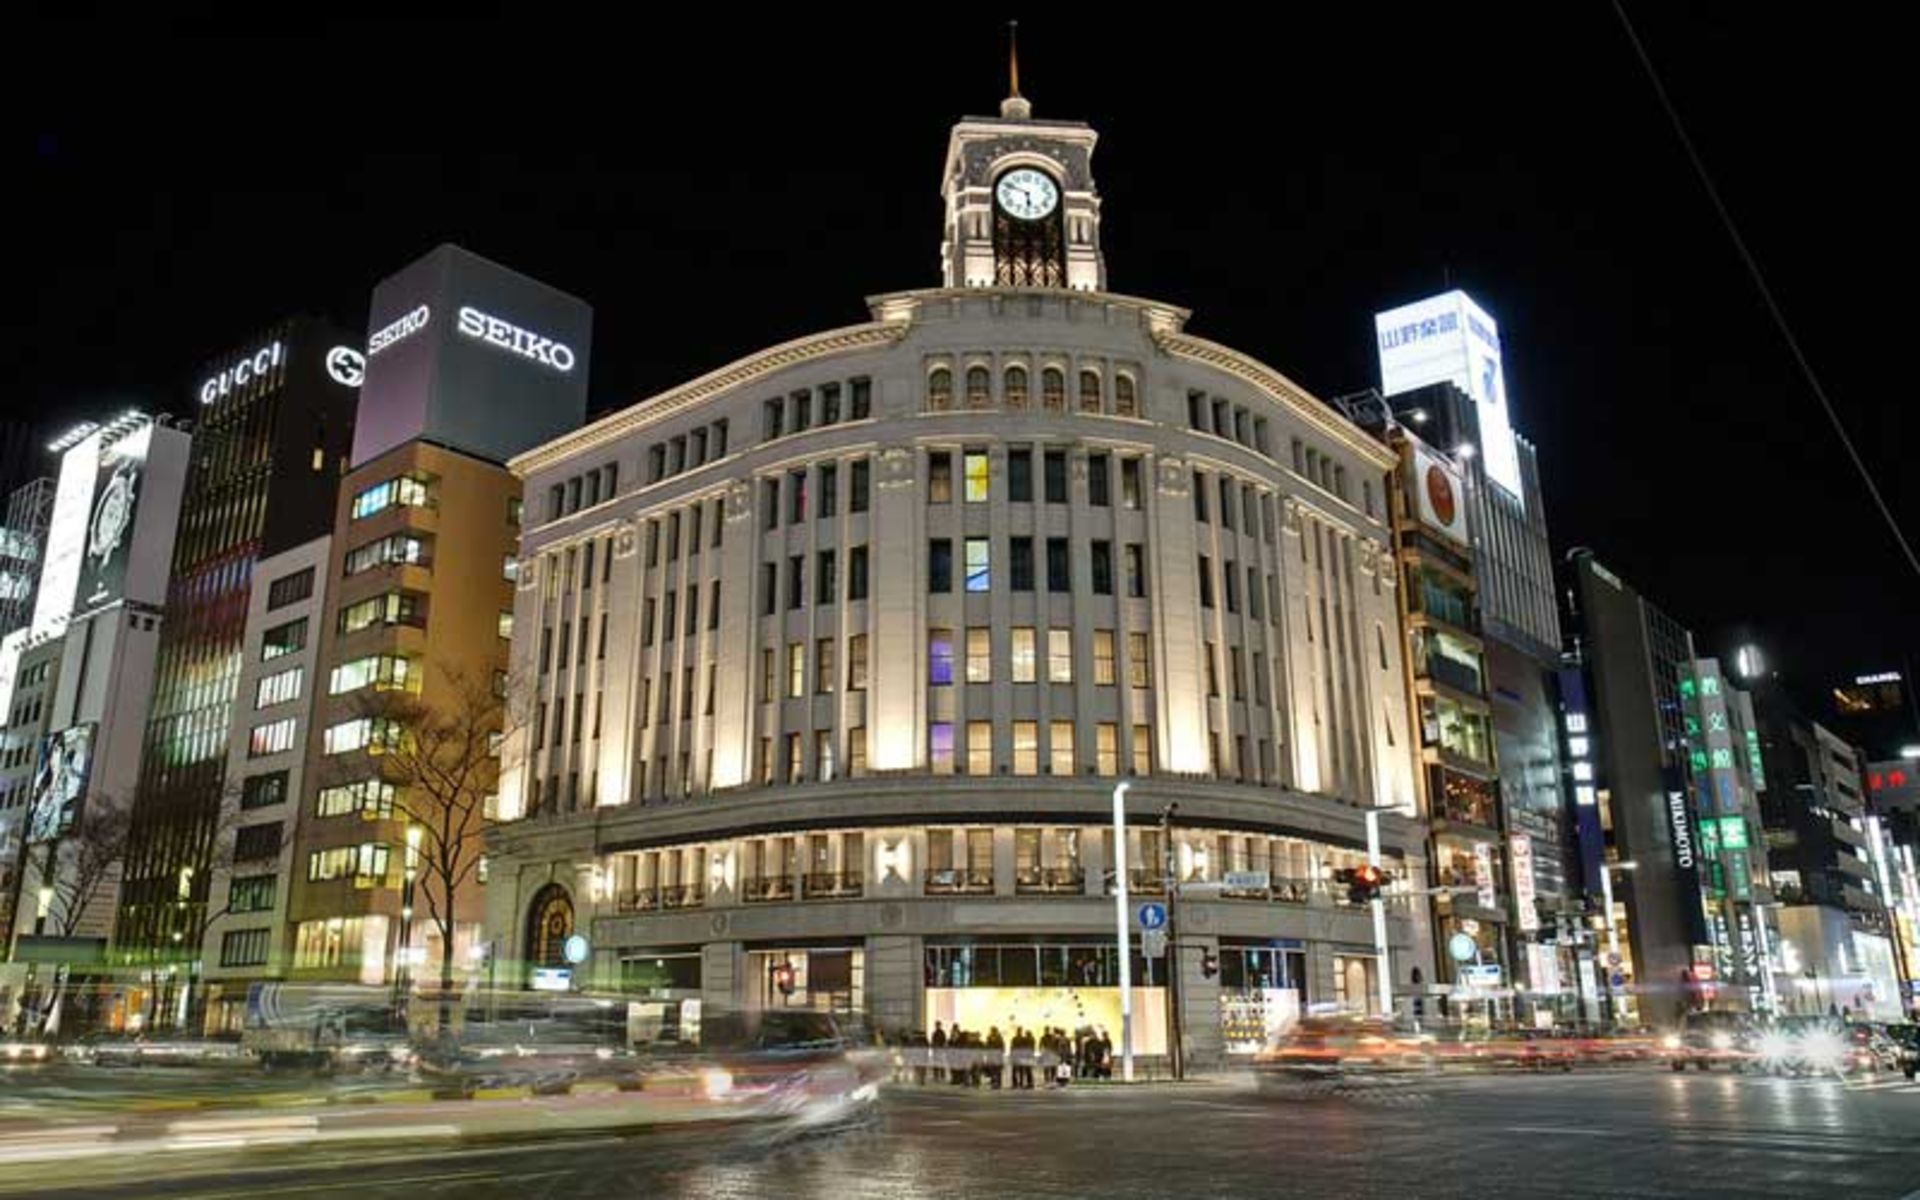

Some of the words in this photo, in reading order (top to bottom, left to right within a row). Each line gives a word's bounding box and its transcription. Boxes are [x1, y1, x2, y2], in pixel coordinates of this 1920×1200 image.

[368, 304, 430, 355] SEIKO
[458, 306, 575, 371] SEIKO
[201, 340, 281, 404] GUCCI
[1669, 791, 1693, 867] MIKIMOTO
